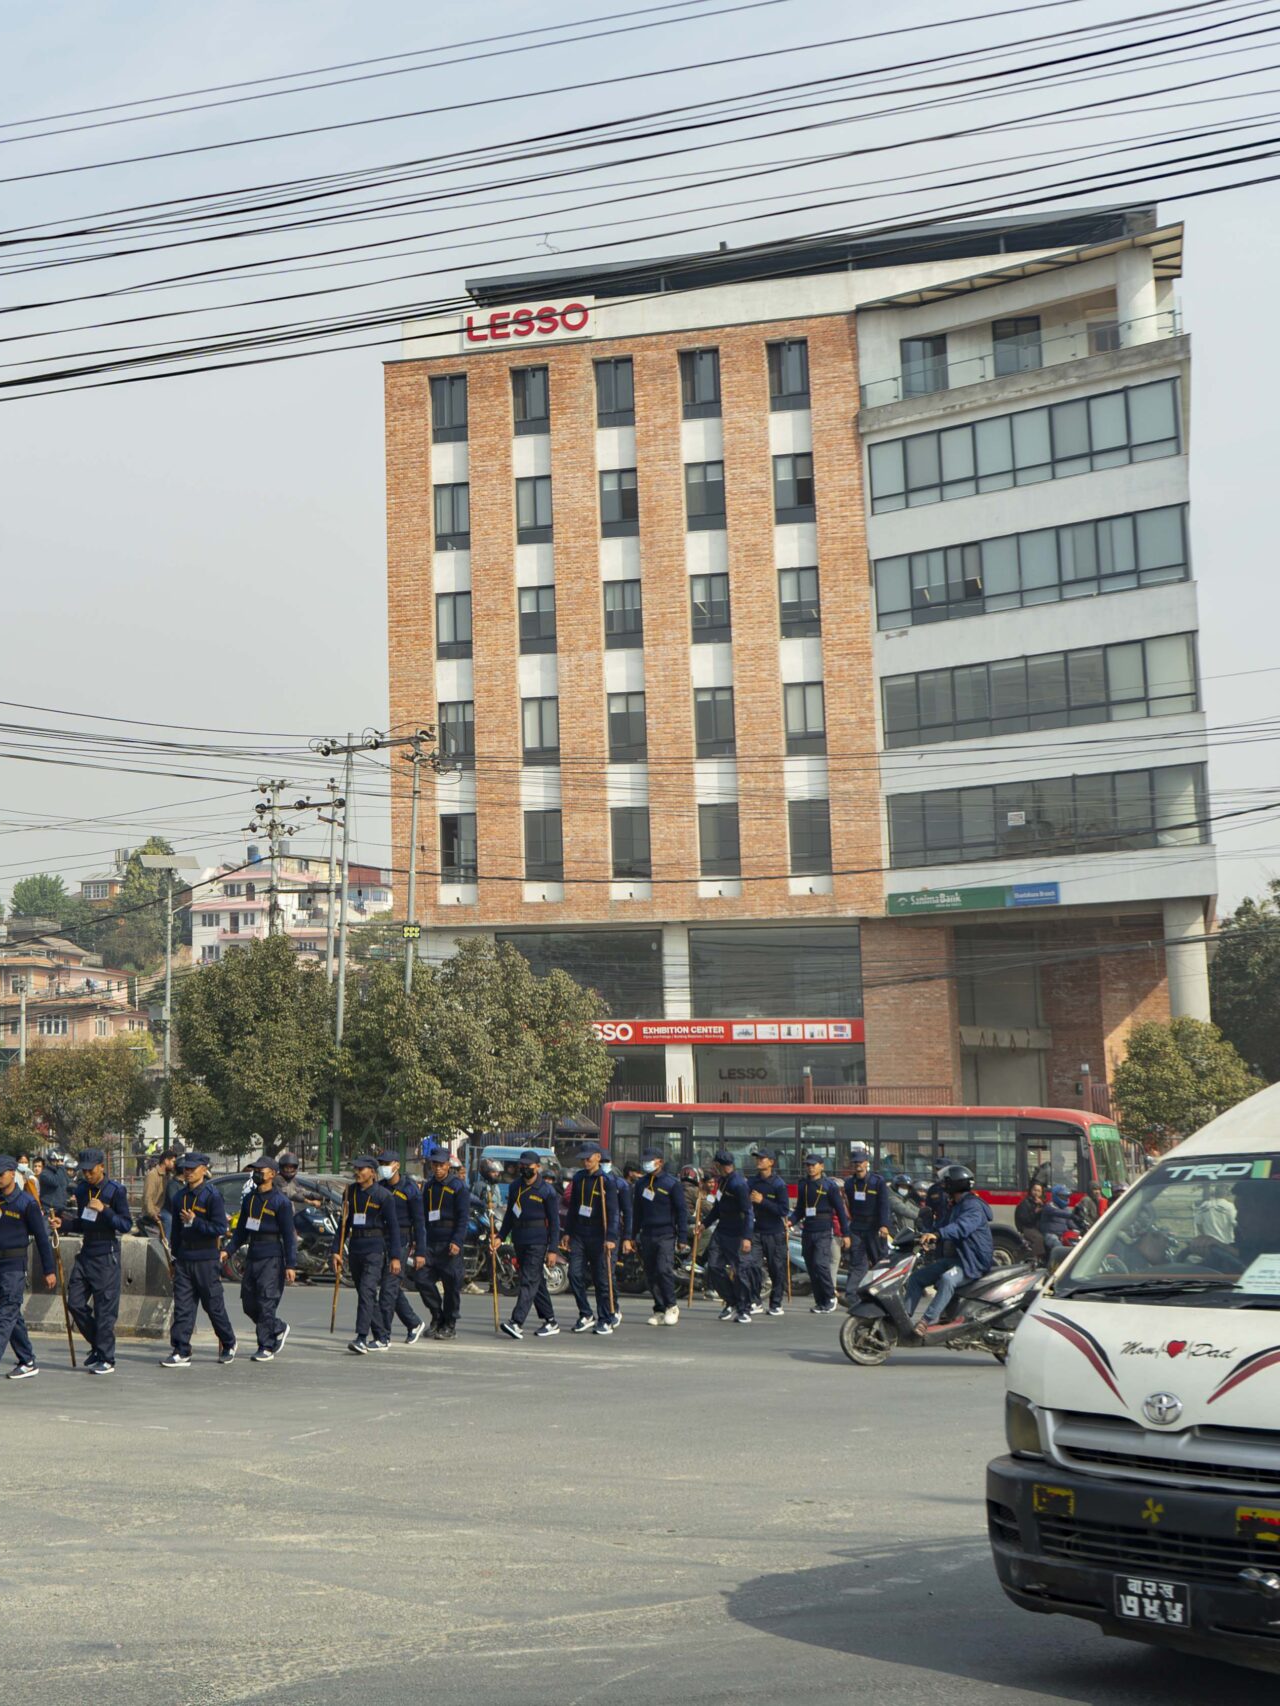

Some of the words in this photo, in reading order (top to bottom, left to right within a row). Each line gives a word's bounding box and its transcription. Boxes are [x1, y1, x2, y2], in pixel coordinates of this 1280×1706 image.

[466, 303, 589, 341] LESSO
[591, 1023, 633, 1041] SSO
[642, 1026, 689, 1035] EXHIBITION
[690, 1025, 725, 1034] CENTER
[718, 1067, 768, 1080] LESSO
[1166, 1162, 1253, 1181] TRD
[1191, 1343, 1238, 1359] Dad
